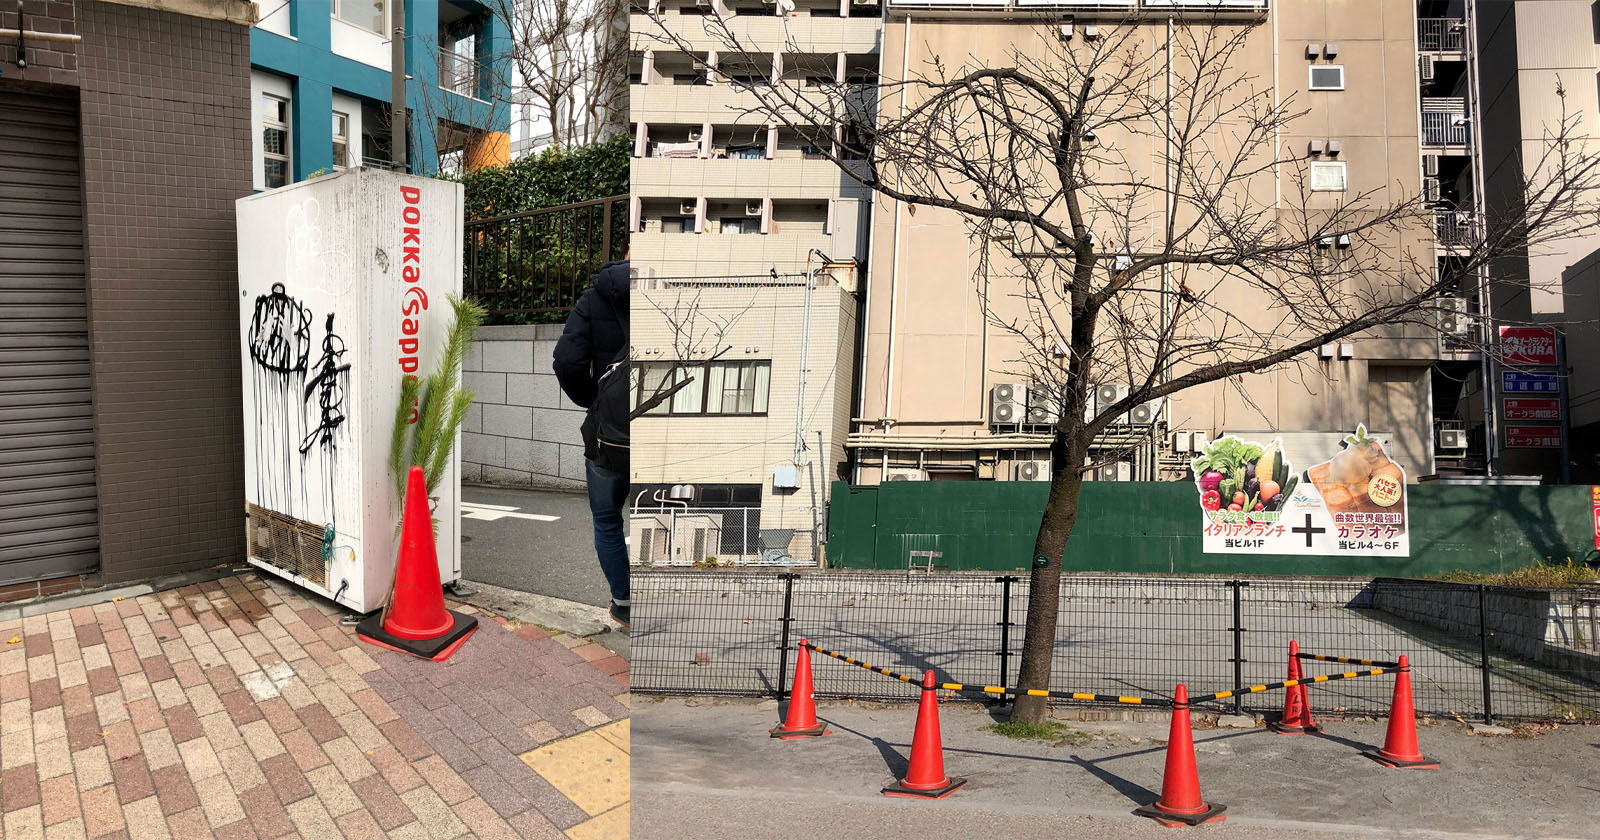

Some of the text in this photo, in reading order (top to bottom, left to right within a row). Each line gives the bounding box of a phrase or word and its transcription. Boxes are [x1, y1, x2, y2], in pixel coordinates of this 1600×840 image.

[1204, 523, 1286, 538] イタリアンランチ
[1338, 526, 1398, 539] カラオケ
[1225, 538, 1265, 549] 当ビル1F
